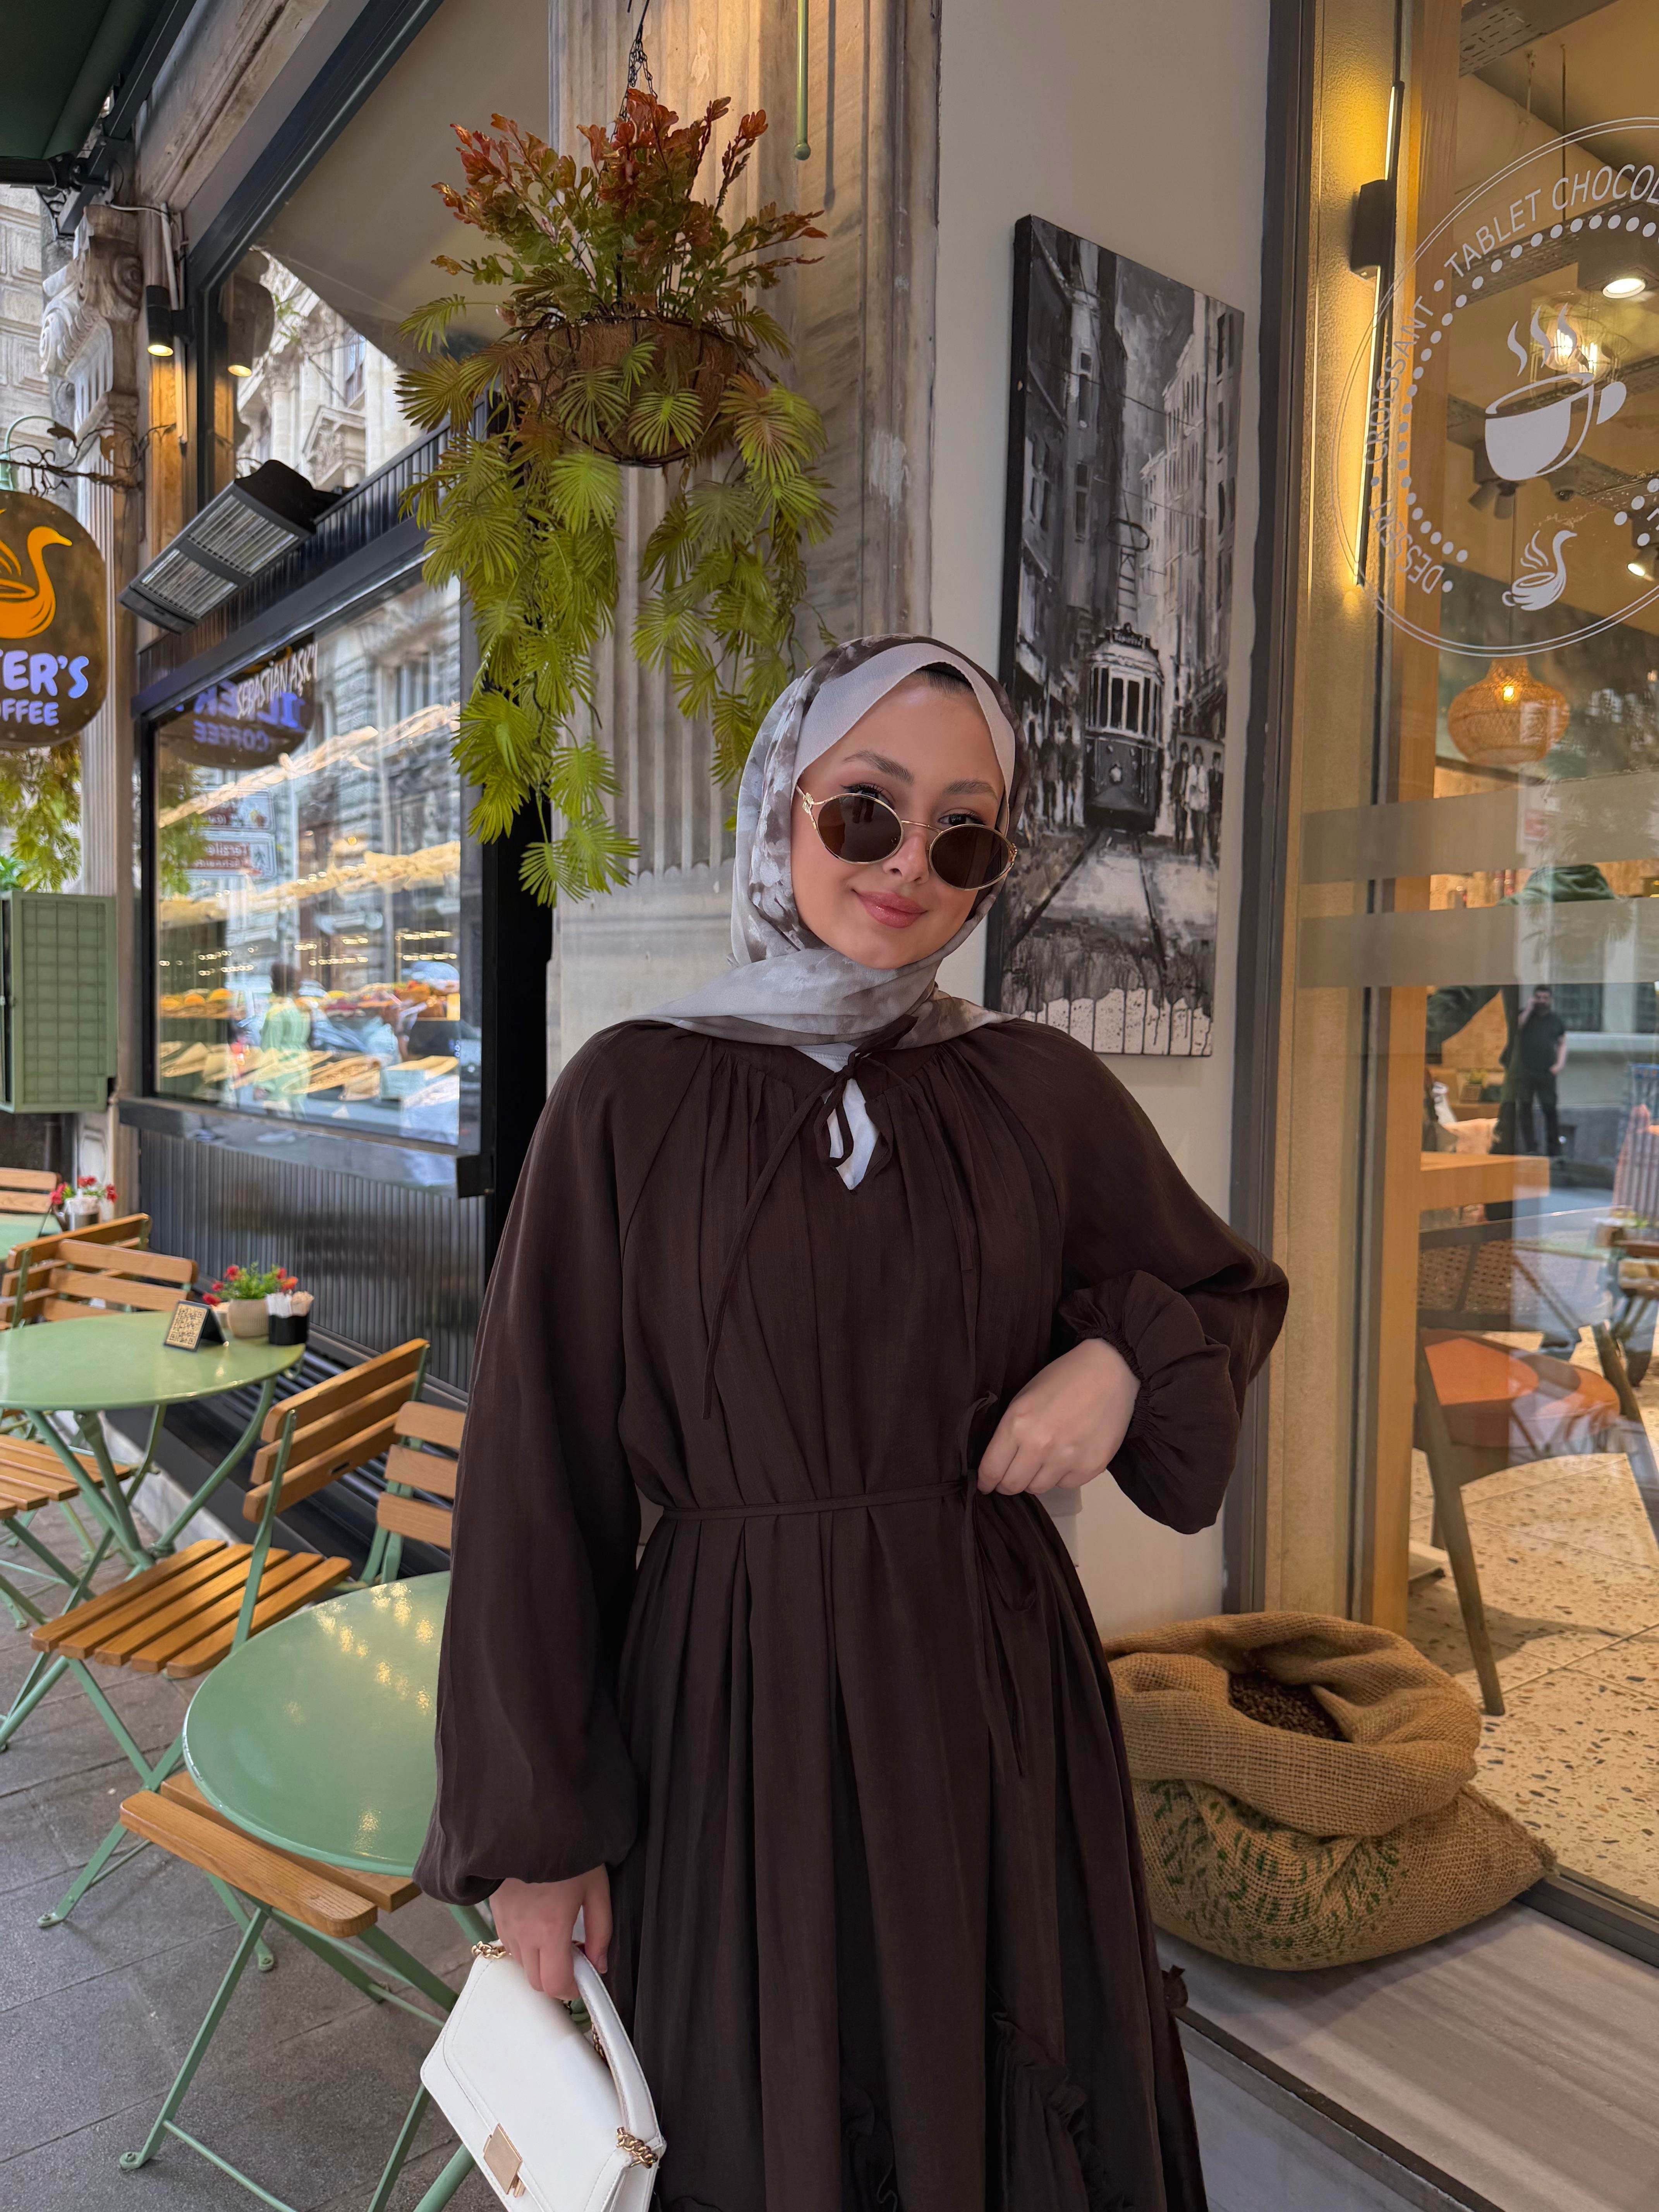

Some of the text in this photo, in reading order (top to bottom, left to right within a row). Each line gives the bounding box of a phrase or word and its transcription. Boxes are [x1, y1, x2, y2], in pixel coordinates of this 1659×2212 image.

[1444, 189, 1541, 278] TABLET
[1366, 295, 1434, 465] CROISSANT
[1369, 499, 1445, 594] DESSERT
[0, 649, 89, 699] ER'S
[0, 697, 59, 726] FFEE
